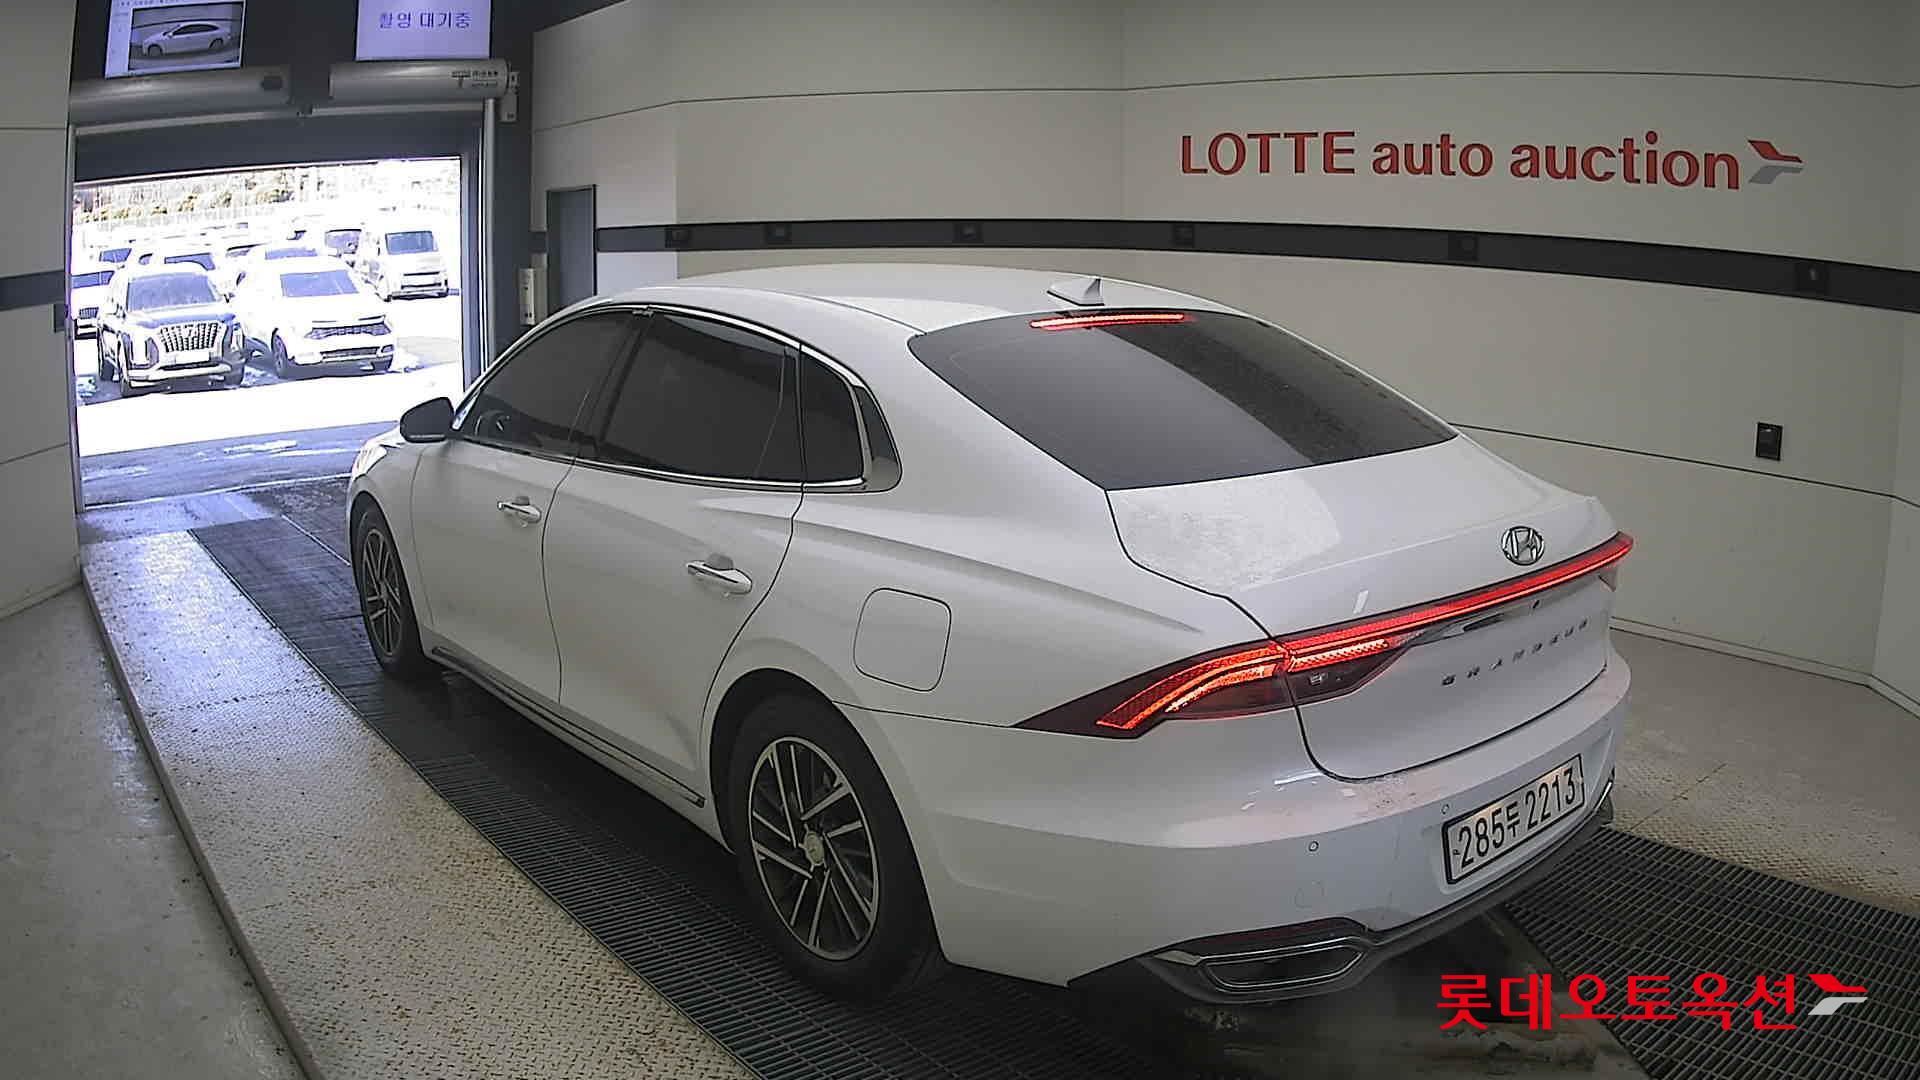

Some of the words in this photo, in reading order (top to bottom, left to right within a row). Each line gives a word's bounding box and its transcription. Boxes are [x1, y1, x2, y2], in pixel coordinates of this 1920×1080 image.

[420, 11, 473, 29] 대기중
[1180, 131, 1356, 176] LOTTE
[1371, 133, 1494, 178] auto
[1509, 130, 1740, 190] auction
[1524, 765, 1576, 831] 2213
